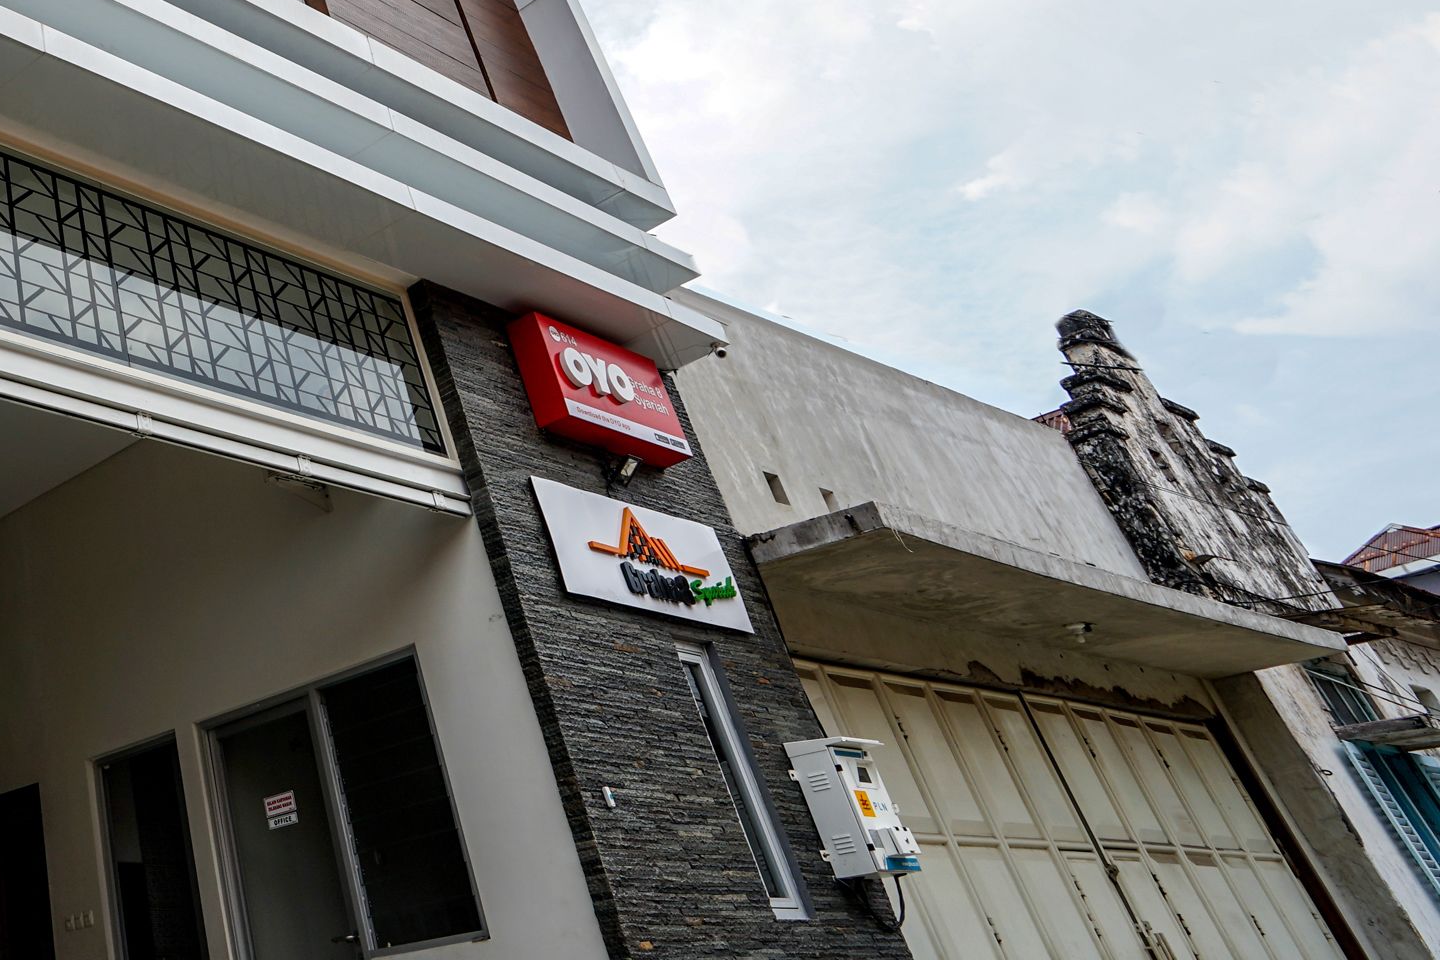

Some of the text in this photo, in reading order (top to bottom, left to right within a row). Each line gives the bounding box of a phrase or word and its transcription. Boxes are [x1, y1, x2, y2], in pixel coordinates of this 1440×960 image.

[560, 332, 577, 346] 614
[559, 347, 634, 403] OYO
[633, 393, 669, 416] Syariah
[576, 406, 601, 420] Download
[873, 801, 888, 812] PLN
[273, 816, 292, 826] OFFICE
